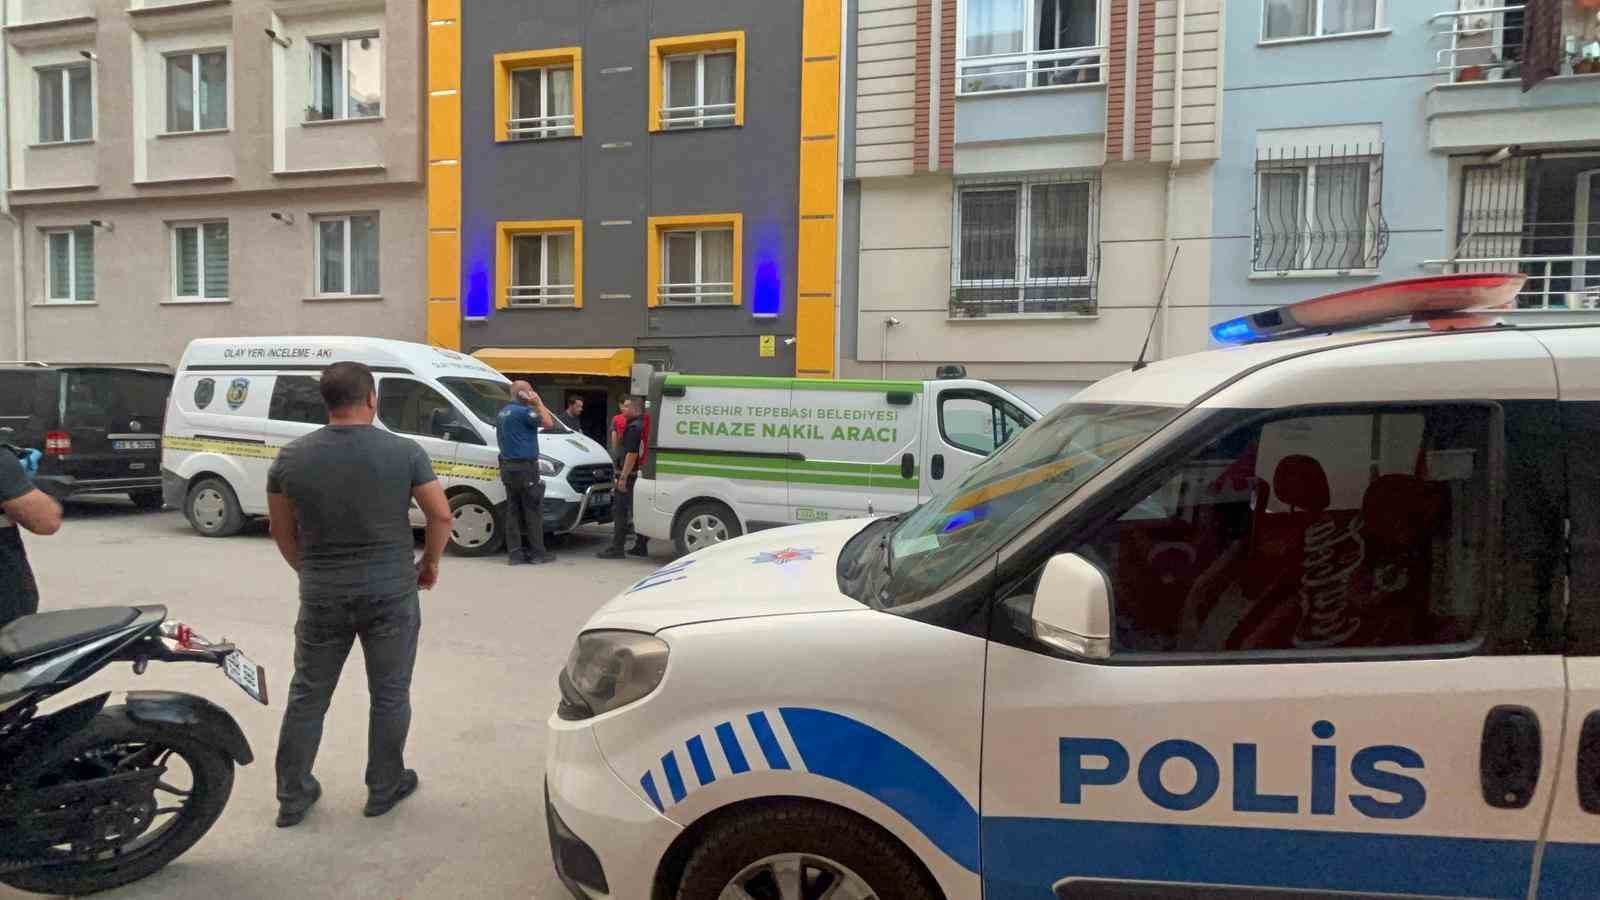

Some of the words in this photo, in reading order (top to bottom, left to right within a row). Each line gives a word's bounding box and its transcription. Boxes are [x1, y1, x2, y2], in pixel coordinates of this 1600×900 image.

[676, 420, 755, 437] CENAZE
[831, 425, 896, 443] ARACI
[1059, 720, 1427, 819] POLİS
